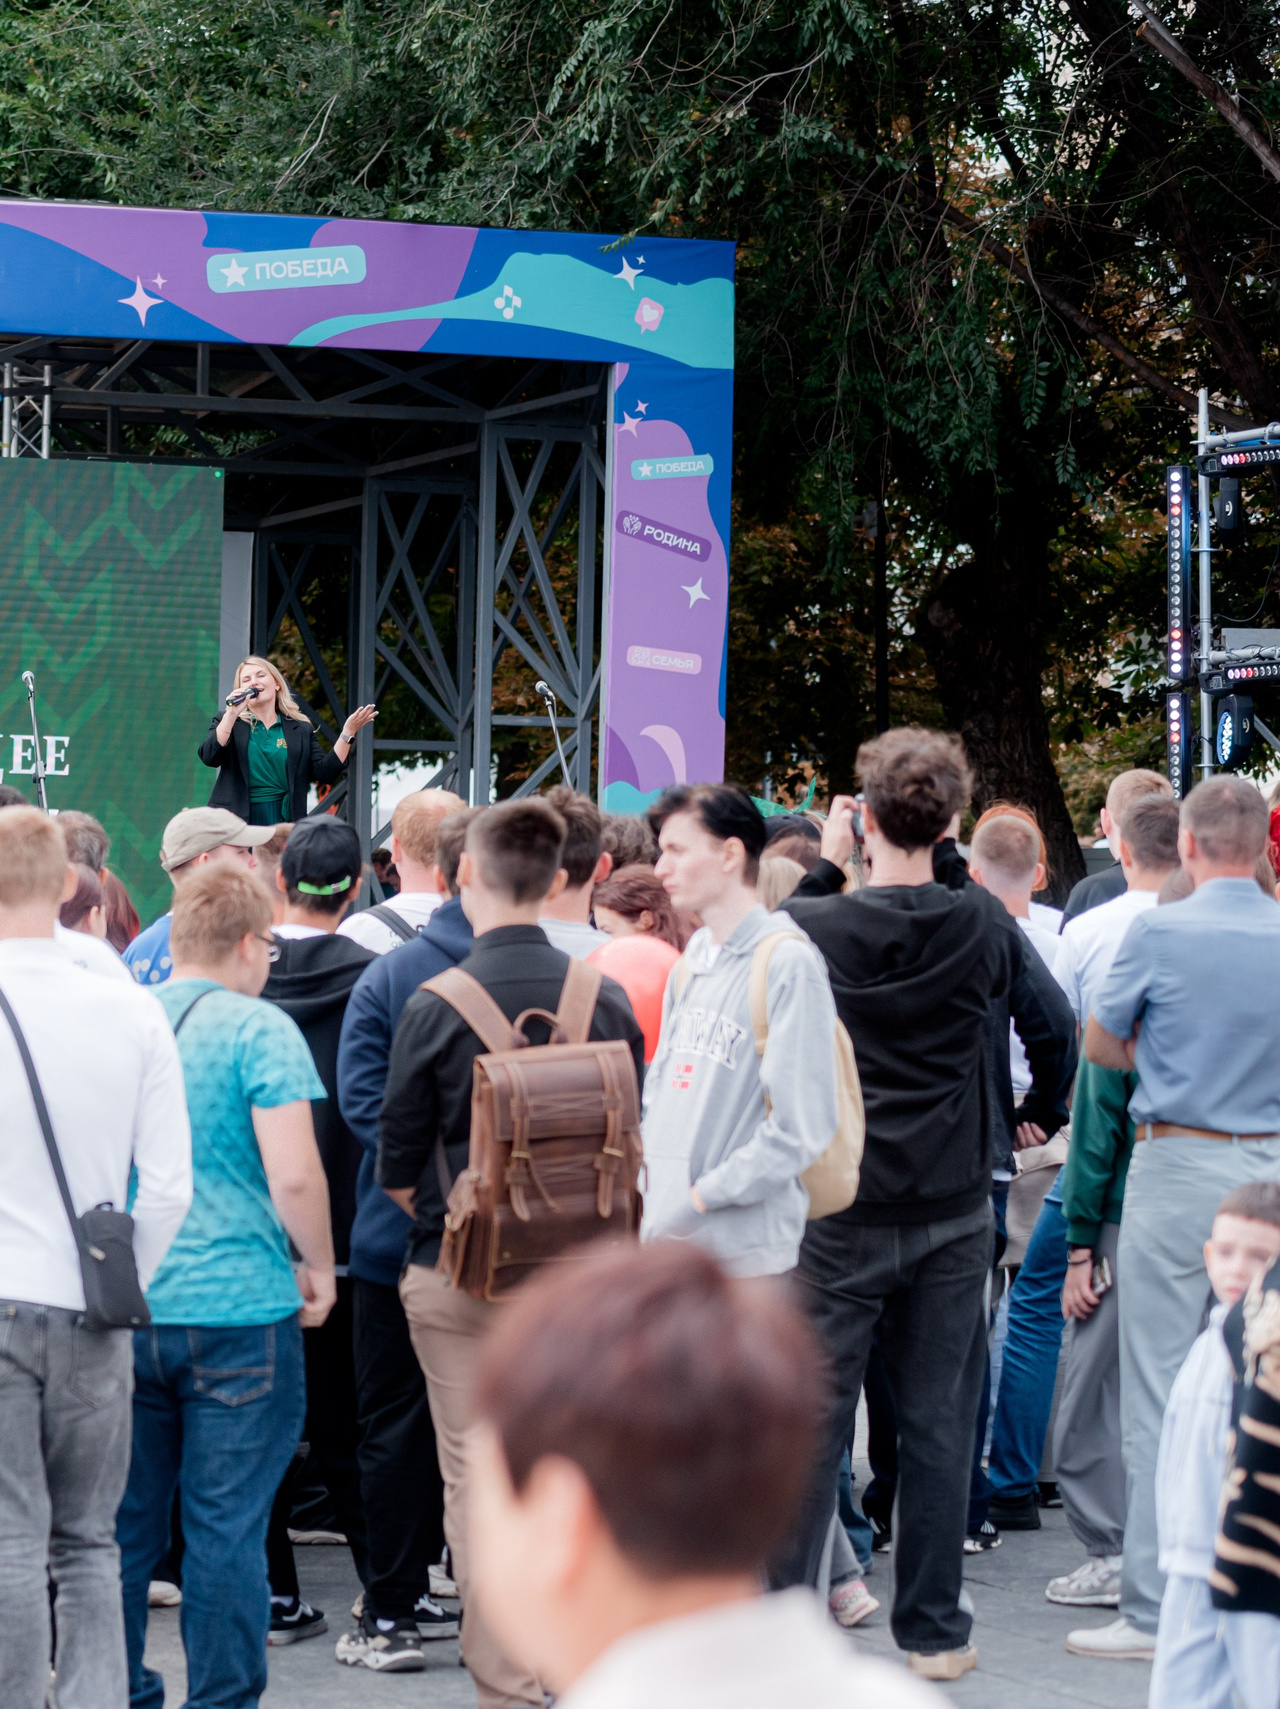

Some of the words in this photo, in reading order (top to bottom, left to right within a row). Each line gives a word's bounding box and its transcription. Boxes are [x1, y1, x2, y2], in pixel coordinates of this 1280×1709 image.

[255, 255, 351, 281] ПОБЕДА
[655, 459, 706, 474] ПОБЕДА
[643, 523, 703, 556] РОДИНА
[651, 653, 695, 670] СЕМЬЯ
